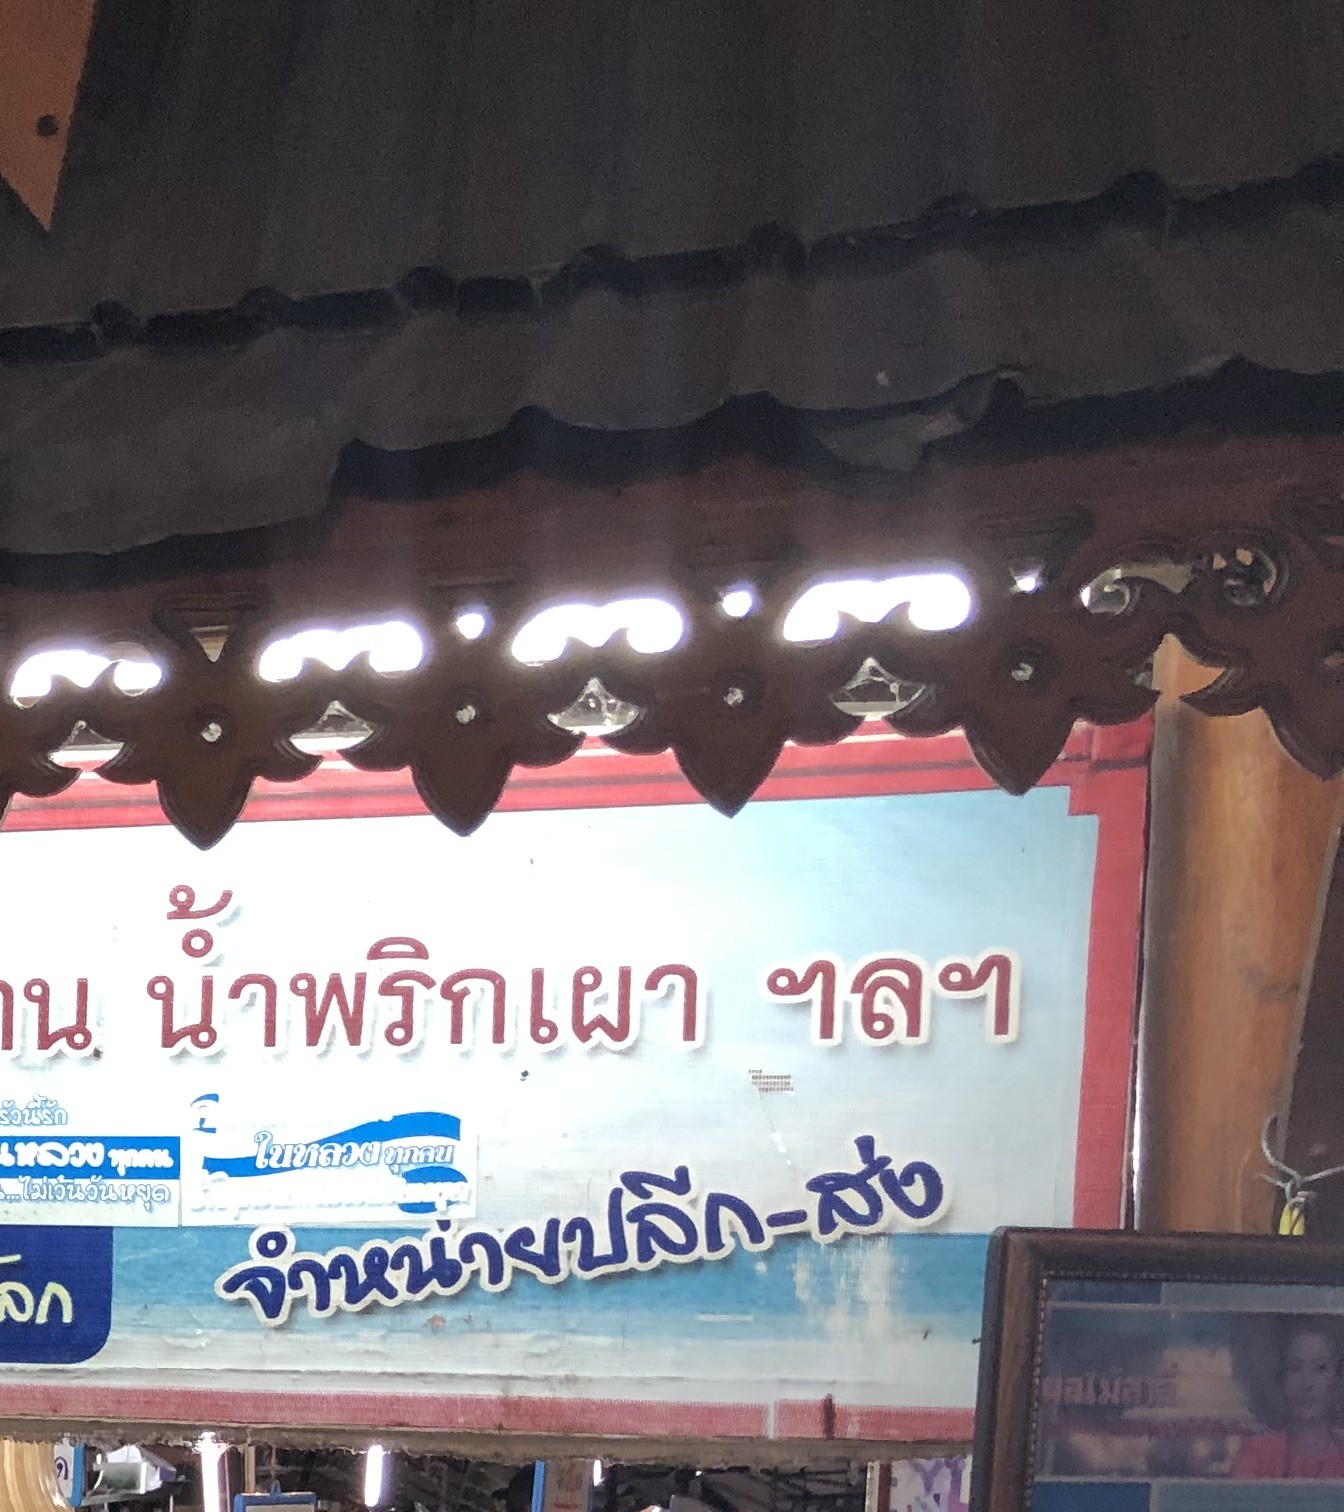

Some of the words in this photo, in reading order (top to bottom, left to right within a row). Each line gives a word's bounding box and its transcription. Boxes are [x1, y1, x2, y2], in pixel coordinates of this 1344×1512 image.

[146, 883, 700, 1052] น้ำพริกเผา
[766, 950, 1014, 1044] ฯลฯ
[222, 1134, 945, 1320] จำหน่ายปลีก-ส่ง
[253, 1130, 382, 1169] ในหลวง
[383, 1144, 456, 1175] ทุกคน
